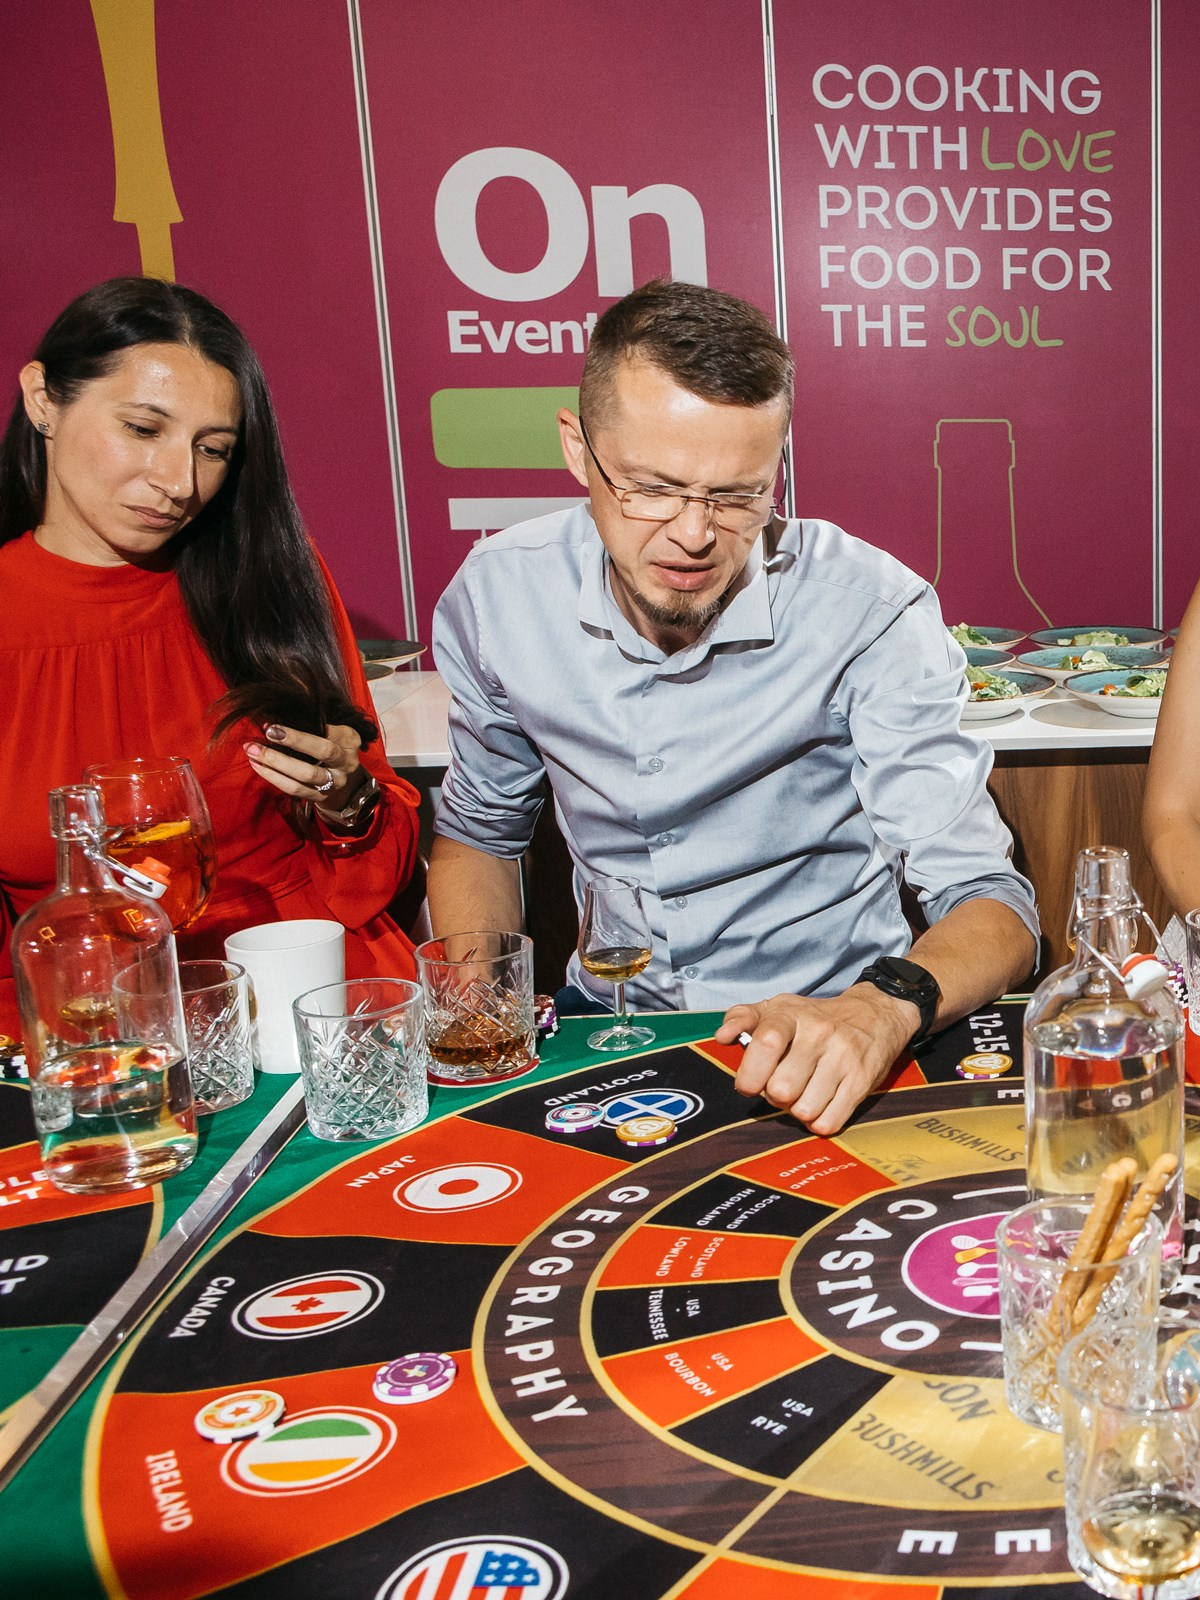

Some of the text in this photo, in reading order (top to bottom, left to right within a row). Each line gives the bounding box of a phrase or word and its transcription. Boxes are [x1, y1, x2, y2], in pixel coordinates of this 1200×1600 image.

[812, 63, 1102, 114] COOKING
[814, 124, 1117, 174] WITH LOVE
[433, 146, 708, 302] On
[818, 185, 1114, 233] PROVIDES
[818, 245, 1113, 292] FOOD FOR
[820, 304, 1064, 348] THE SOUL
[968, 1012, 1011, 1053] 12-15
[544, 1069, 659, 1107] SCOTLAND
[913, 1117, 1024, 1163] BUSHMILLS
[346, 1154, 417, 1189] JAPAN
[779, 1155, 832, 1177] ISLAND
[790, 1162, 858, 1190] SCOTLAND
[696, 1186, 756, 1228] HIGHLAND
[726, 1194, 781, 1230] SCOTLAND
[655, 1236, 691, 1277] LOWLAND
[690, 1236, 725, 1278] SCOTLAND
[818, 1198, 941, 1352] CASINO
[167, 1276, 236, 1339] CANADA
[504, 1184, 651, 1424] GEOGRAPHY
[648, 1289, 670, 1341] TENNESSEE
[686, 1298, 701, 1318] USA
[664, 1352, 717, 1397] BOURBON
[710, 1352, 735, 1372] USA
[750, 1415, 788, 1436] RYE
[781, 1398, 815, 1417] USA
[144, 1449, 194, 1533] IRELAND
